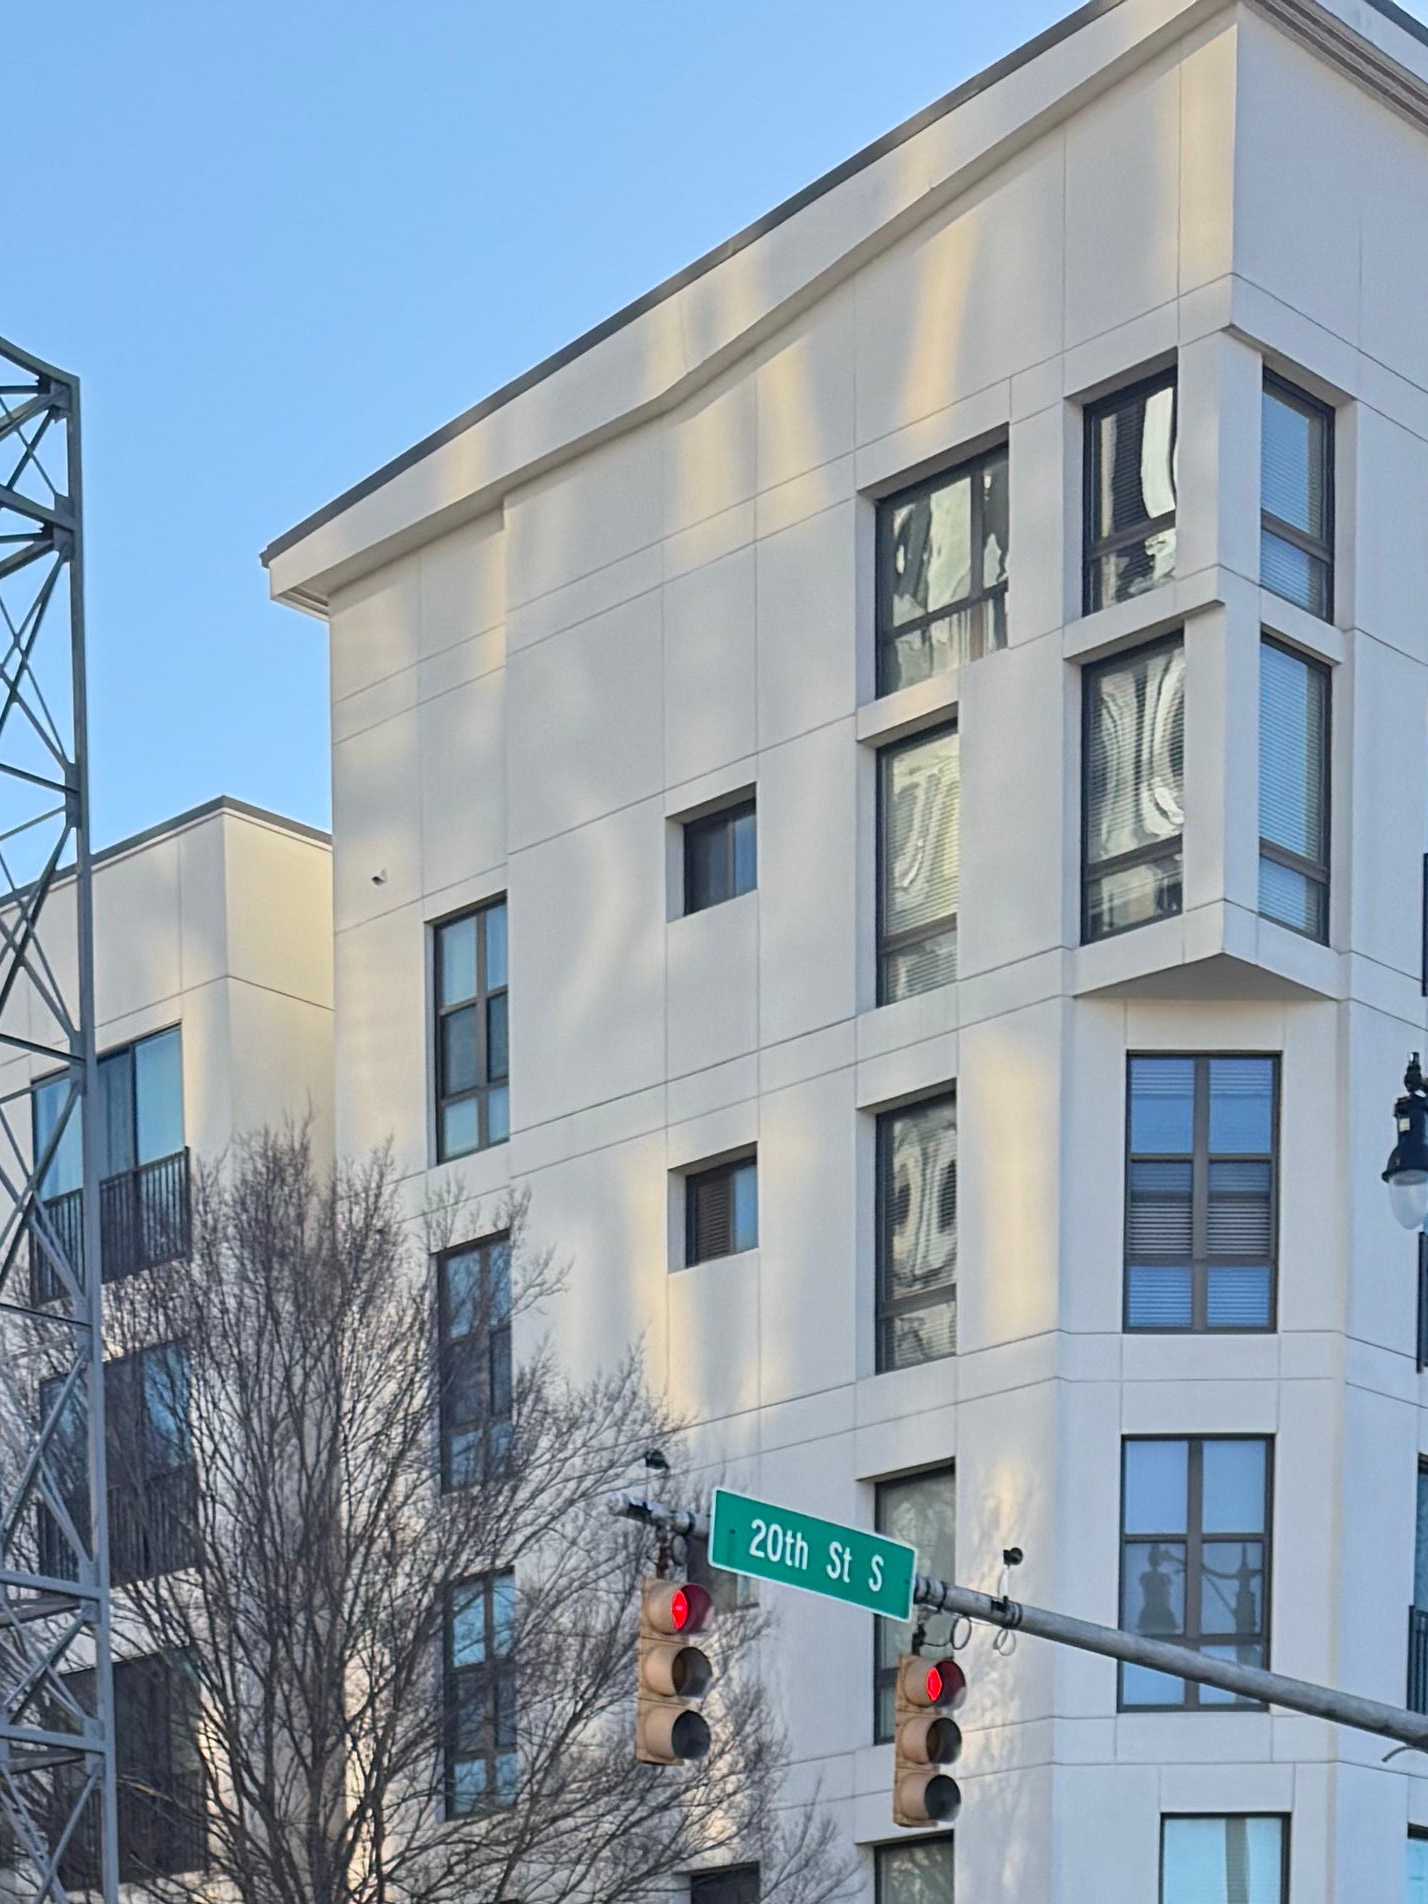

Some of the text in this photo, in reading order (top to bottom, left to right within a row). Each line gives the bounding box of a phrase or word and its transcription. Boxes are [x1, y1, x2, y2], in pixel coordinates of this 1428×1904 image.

[748, 1518, 885, 1593] 20th St S
